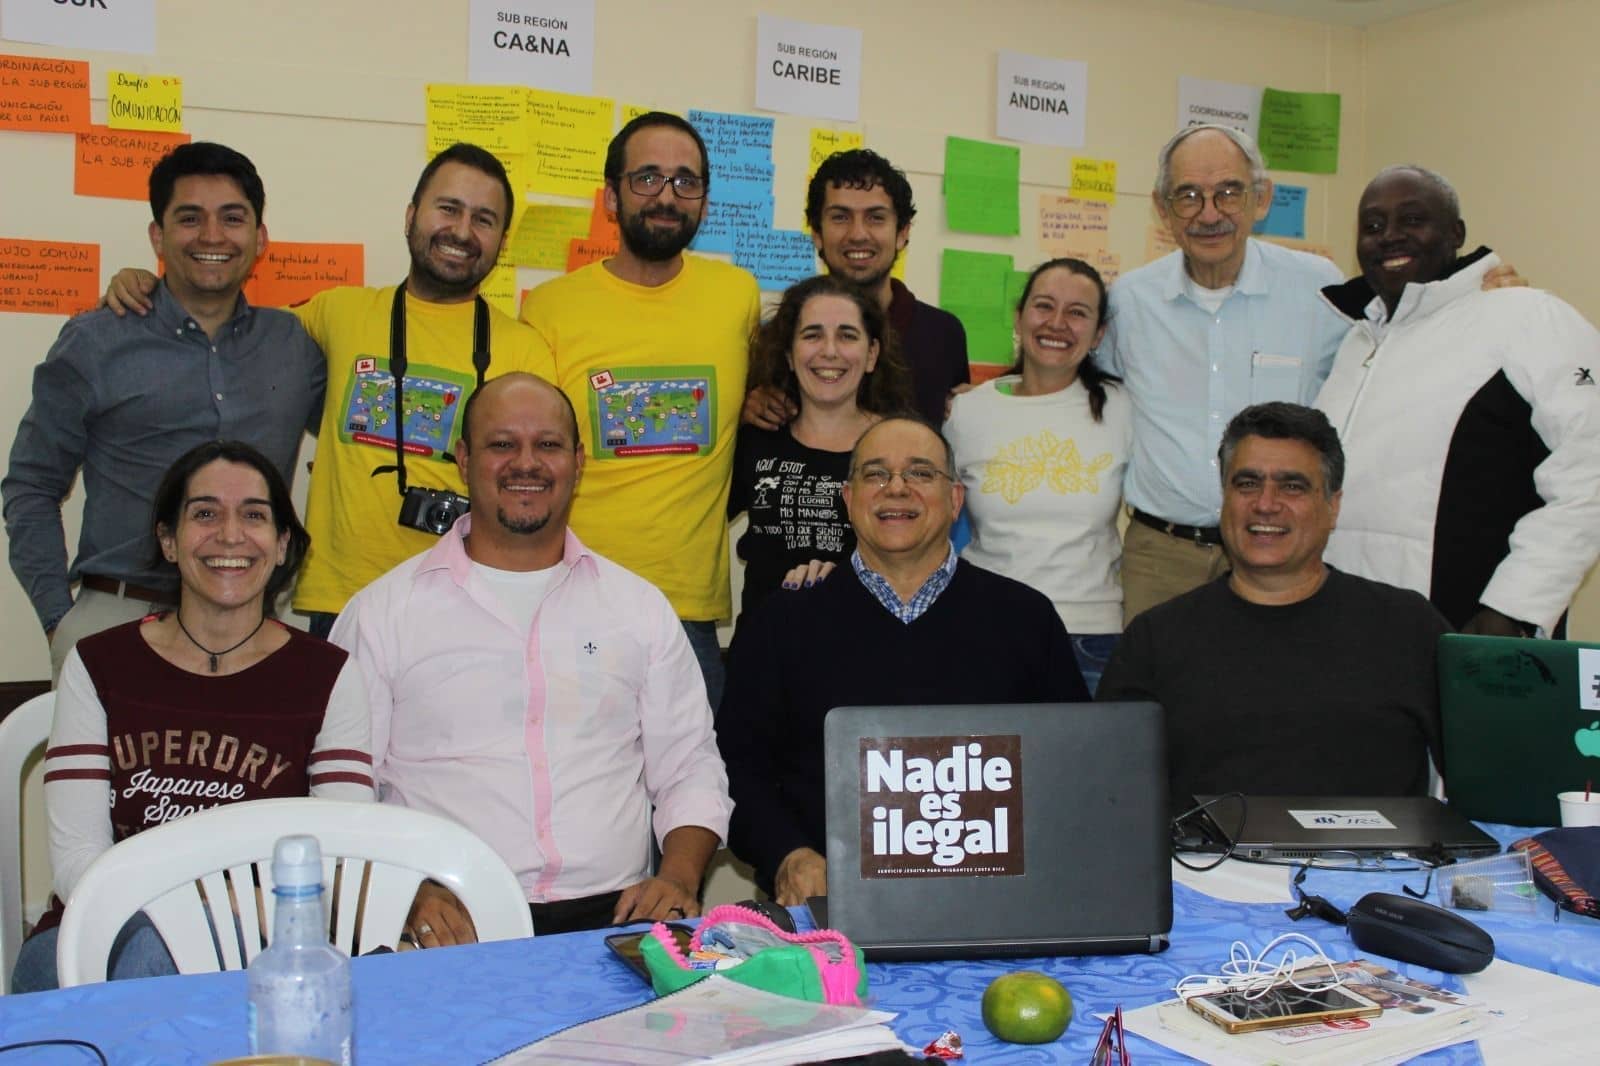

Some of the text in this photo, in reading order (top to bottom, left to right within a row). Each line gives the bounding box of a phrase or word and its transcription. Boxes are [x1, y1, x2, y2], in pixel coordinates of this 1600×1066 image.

[496, 12, 568, 30] SUB REGIÓN
[494, 30, 570, 56] CA&NA
[777, 42, 837, 60] SUB REGIÓN
[772, 60, 840, 85] CARIBE
[1013, 75, 1029, 86] SUB
[1009, 91, 1069, 115] ANDINA
[83, 152, 103, 165] LA
[779, 461, 806, 474] ESTOY
[780, 494, 794, 504] MIS
[782, 486, 796, 494] CON
[780, 507, 794, 518] MIS
[786, 526, 794, 534] LO
[798, 526, 812, 534] QUE
[816, 526, 844, 536] SIENTO
[110, 730, 292, 790] UPERDRY
[866, 742, 1012, 792] Nadie
[123, 769, 245, 800] Japanese
[920, 792, 962, 820] es
[872, 806, 1008, 866] ilegal
